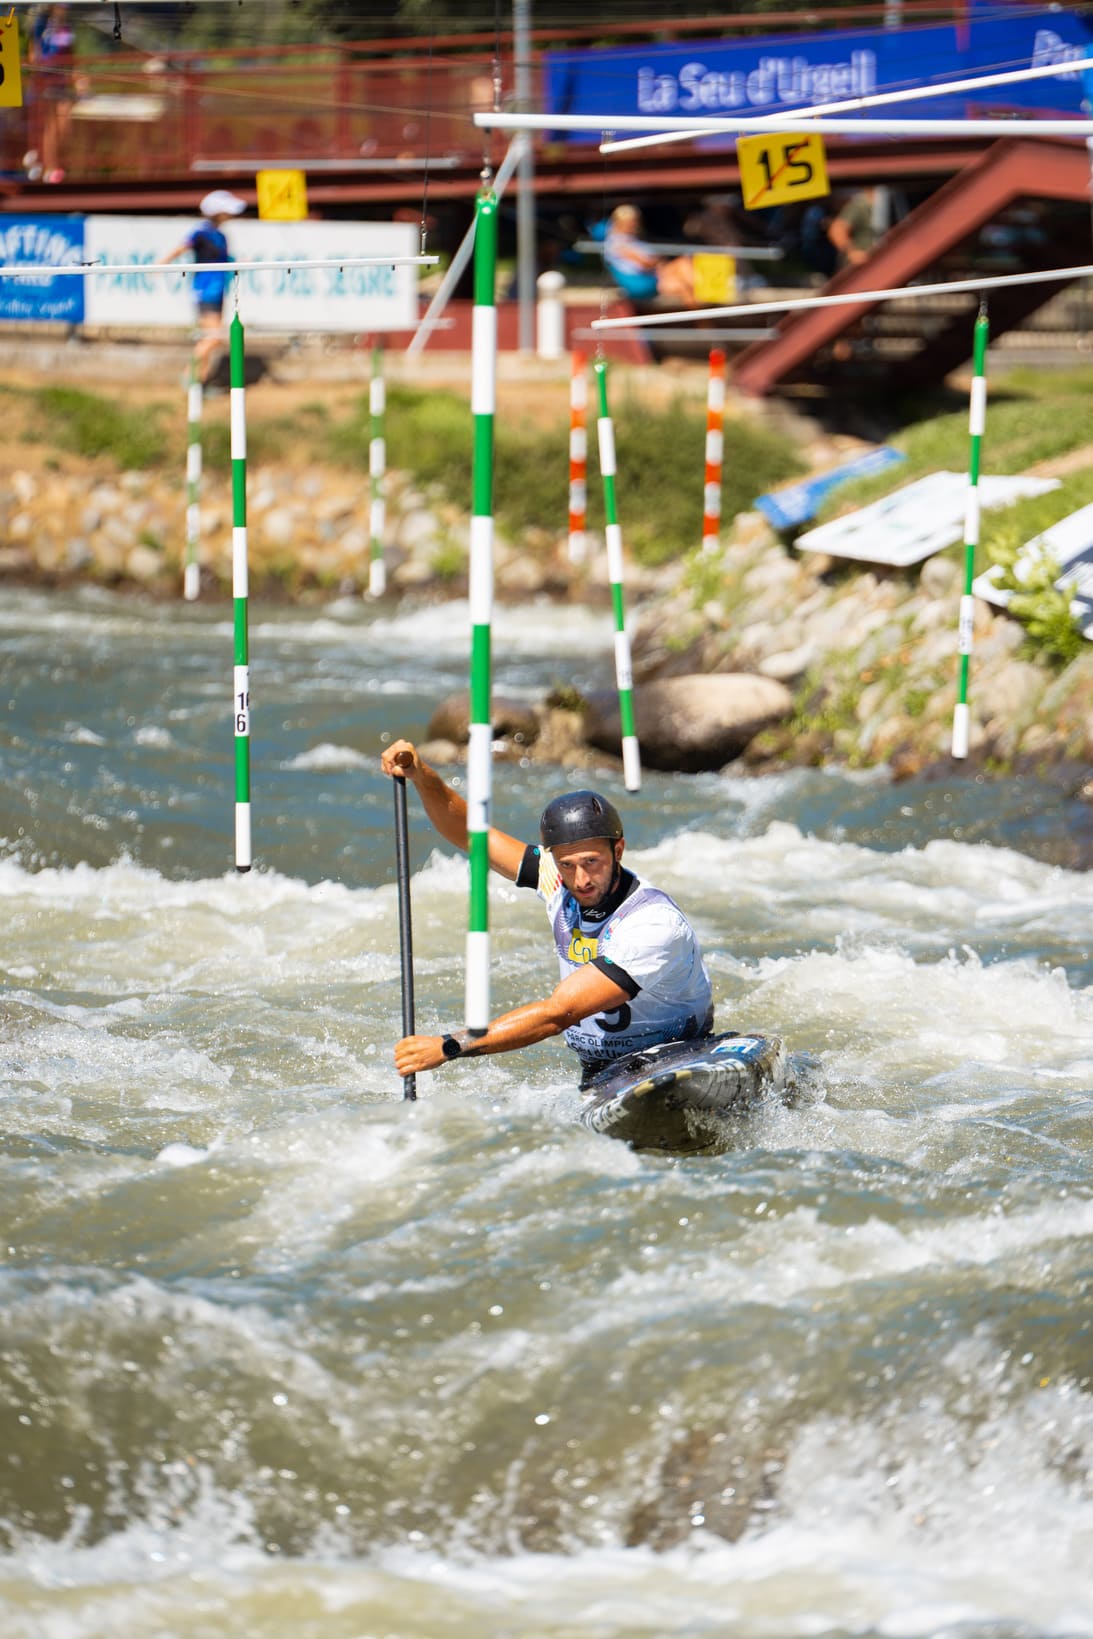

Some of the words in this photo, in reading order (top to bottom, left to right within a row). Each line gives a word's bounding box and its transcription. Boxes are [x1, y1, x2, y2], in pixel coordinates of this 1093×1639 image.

[637, 66, 679, 113] La
[679, 61, 747, 111] Seu
[747, 49, 877, 106] d'Urgell
[757, 140, 814, 191] 15
[588, 1038, 633, 1048] OLIMPIC
